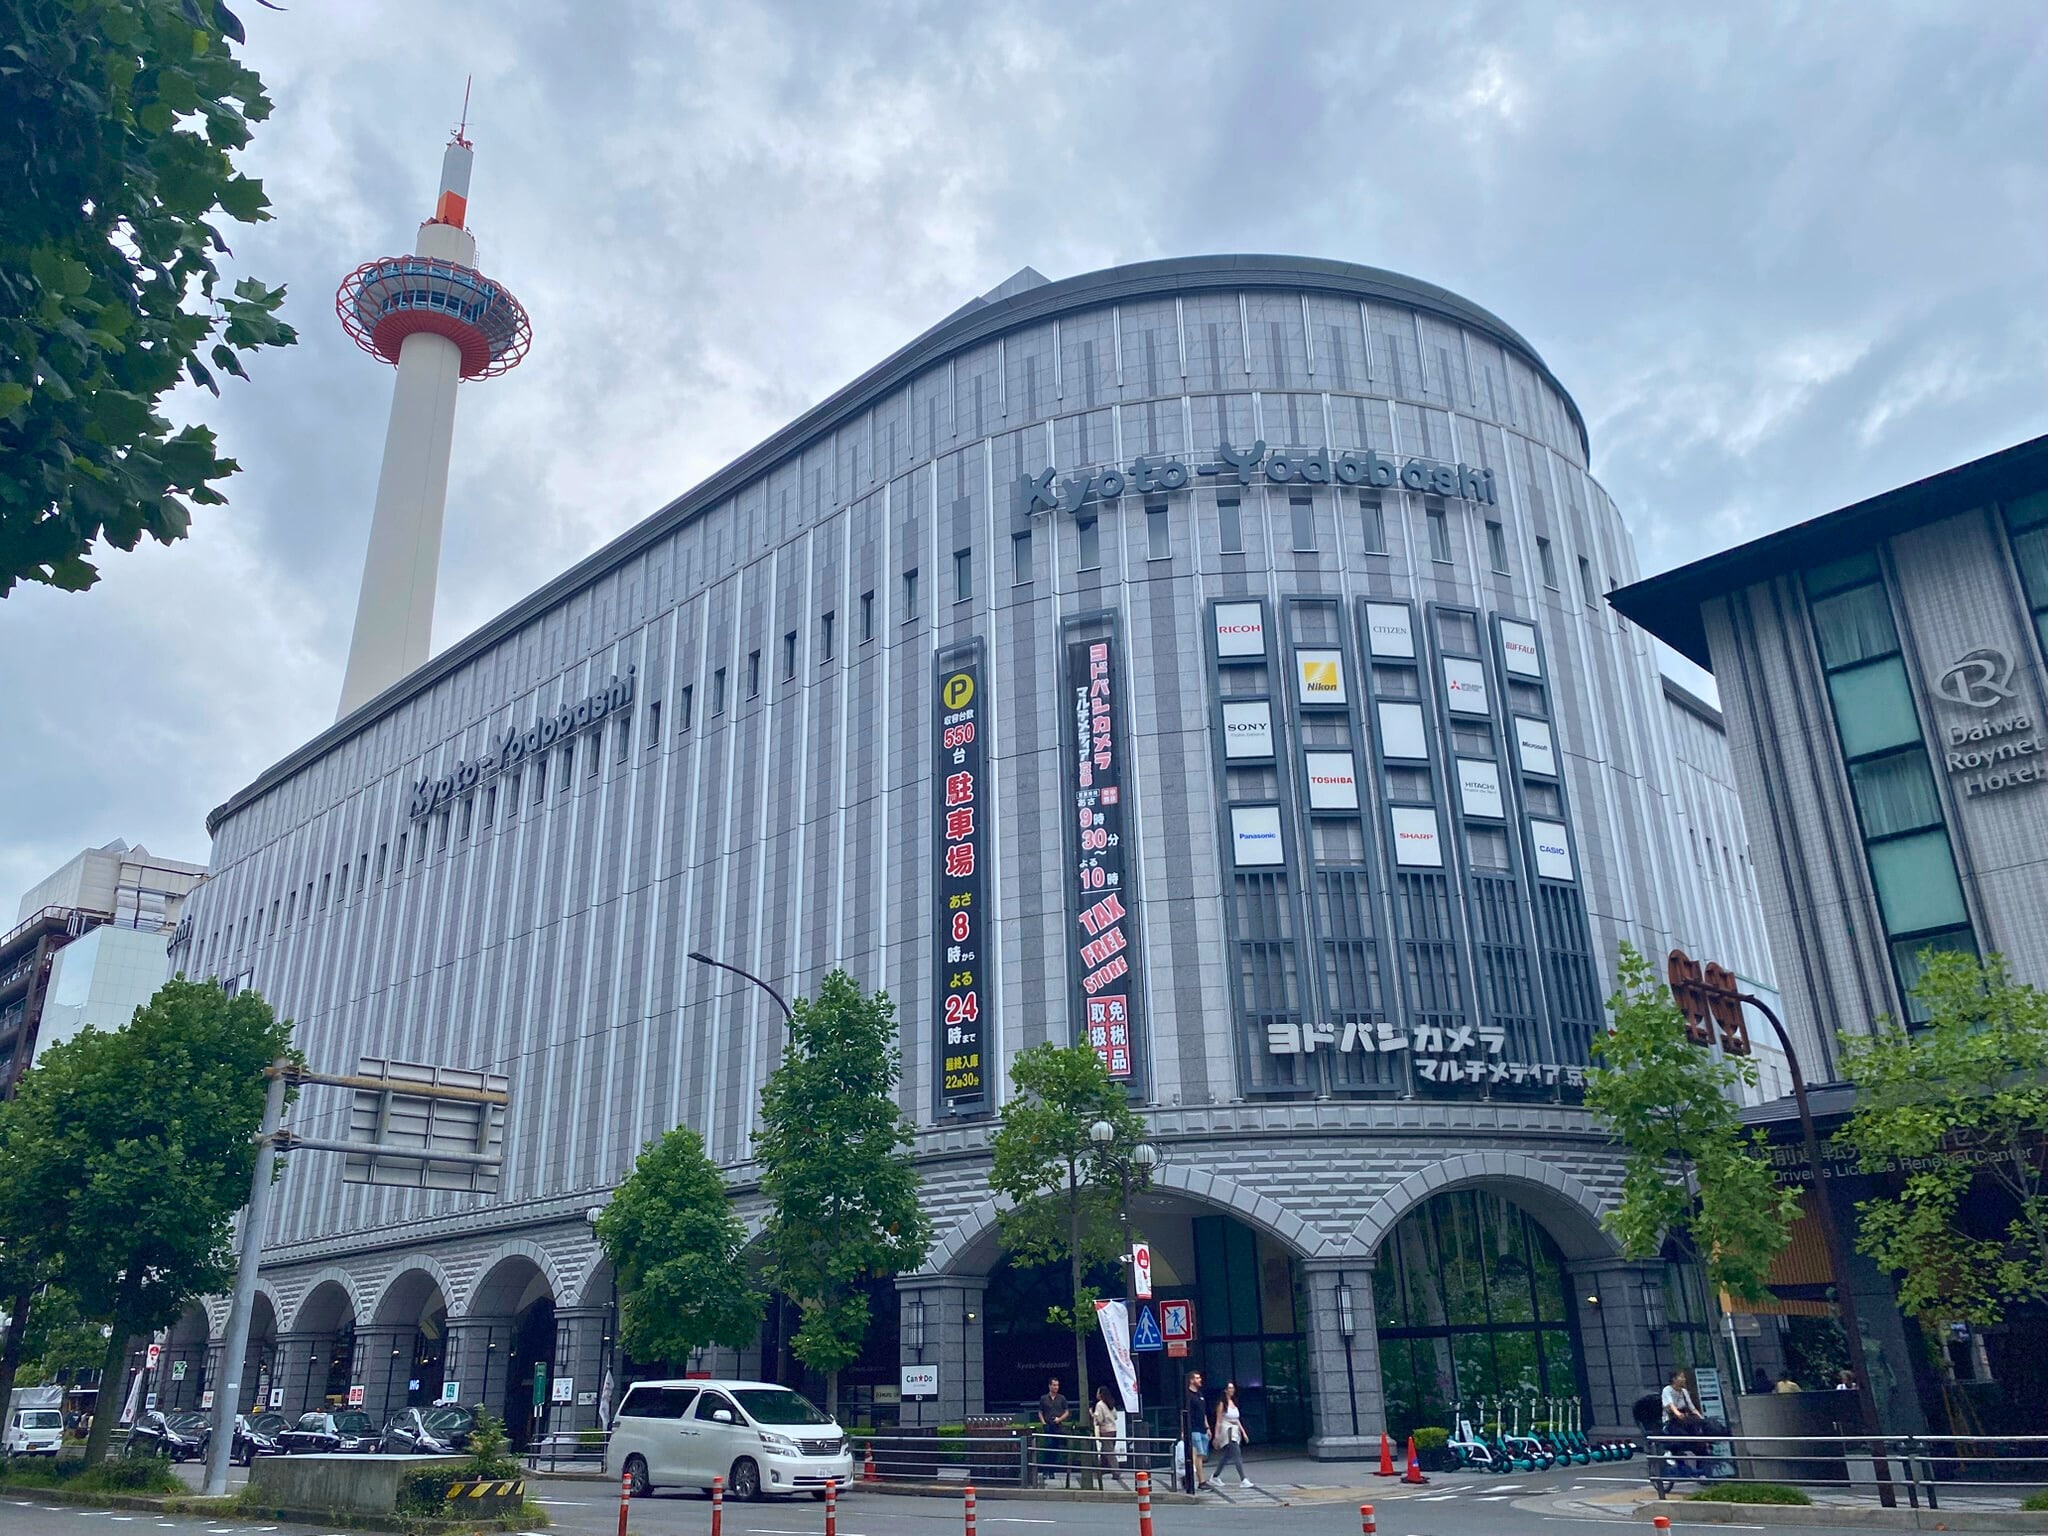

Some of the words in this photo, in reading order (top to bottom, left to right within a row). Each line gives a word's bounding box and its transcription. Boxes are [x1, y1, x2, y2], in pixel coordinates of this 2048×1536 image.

[1020, 439, 1497, 516] Kyoto-Yodobashi
[1218, 624, 1261, 634] RICOH
[1372, 625, 1407, 635] CITIZEN
[1505, 641, 1536, 656] BUFFALO
[951, 679, 967, 705] P
[1306, 682, 1337, 692] Nikon
[1089, 643, 1111, 770] ヨドバシカメラ
[944, 722, 975, 749] 550
[1227, 723, 1267, 731] SONY
[1950, 713, 2032, 746] Daiwa
[409, 664, 636, 818] Kyoto-Yodobashi
[1521, 740, 1548, 751] Microsoft
[953, 747, 966, 765] 台
[1946, 734, 2046, 773] Roynet
[1311, 776, 1353, 784] TOSHIBA
[1464, 782, 1496, 790] HITACHI
[1963, 760, 2041, 796] Hotel
[1077, 797, 1096, 807] あさ
[945, 771, 974, 877] 駐車場
[1082, 828, 1119, 850] 30分
[1239, 832, 1276, 840] Panasonic
[1399, 832, 1433, 840] SHARP
[1539, 845, 1565, 856] CASIO
[1079, 858, 1098, 868] よる
[1080, 867, 1119, 889] 10時
[949, 892, 972, 909] あさ
[1079, 892, 1126, 936] TAX
[952, 911, 970, 942] 8
[947, 946, 975, 963] 時から
[1080, 926, 1127, 969] FREE
[949, 971, 973, 988] よる
[1082, 955, 1128, 994] STORE
[945, 991, 978, 1025] 24
[948, 1027, 976, 1045] 時まで
[1109, 1001, 1127, 1070] 免税品
[1267, 1023, 1505, 1054] ヨドバシカメラ
[1415, 1059, 1597, 1088] マルチメディア京
